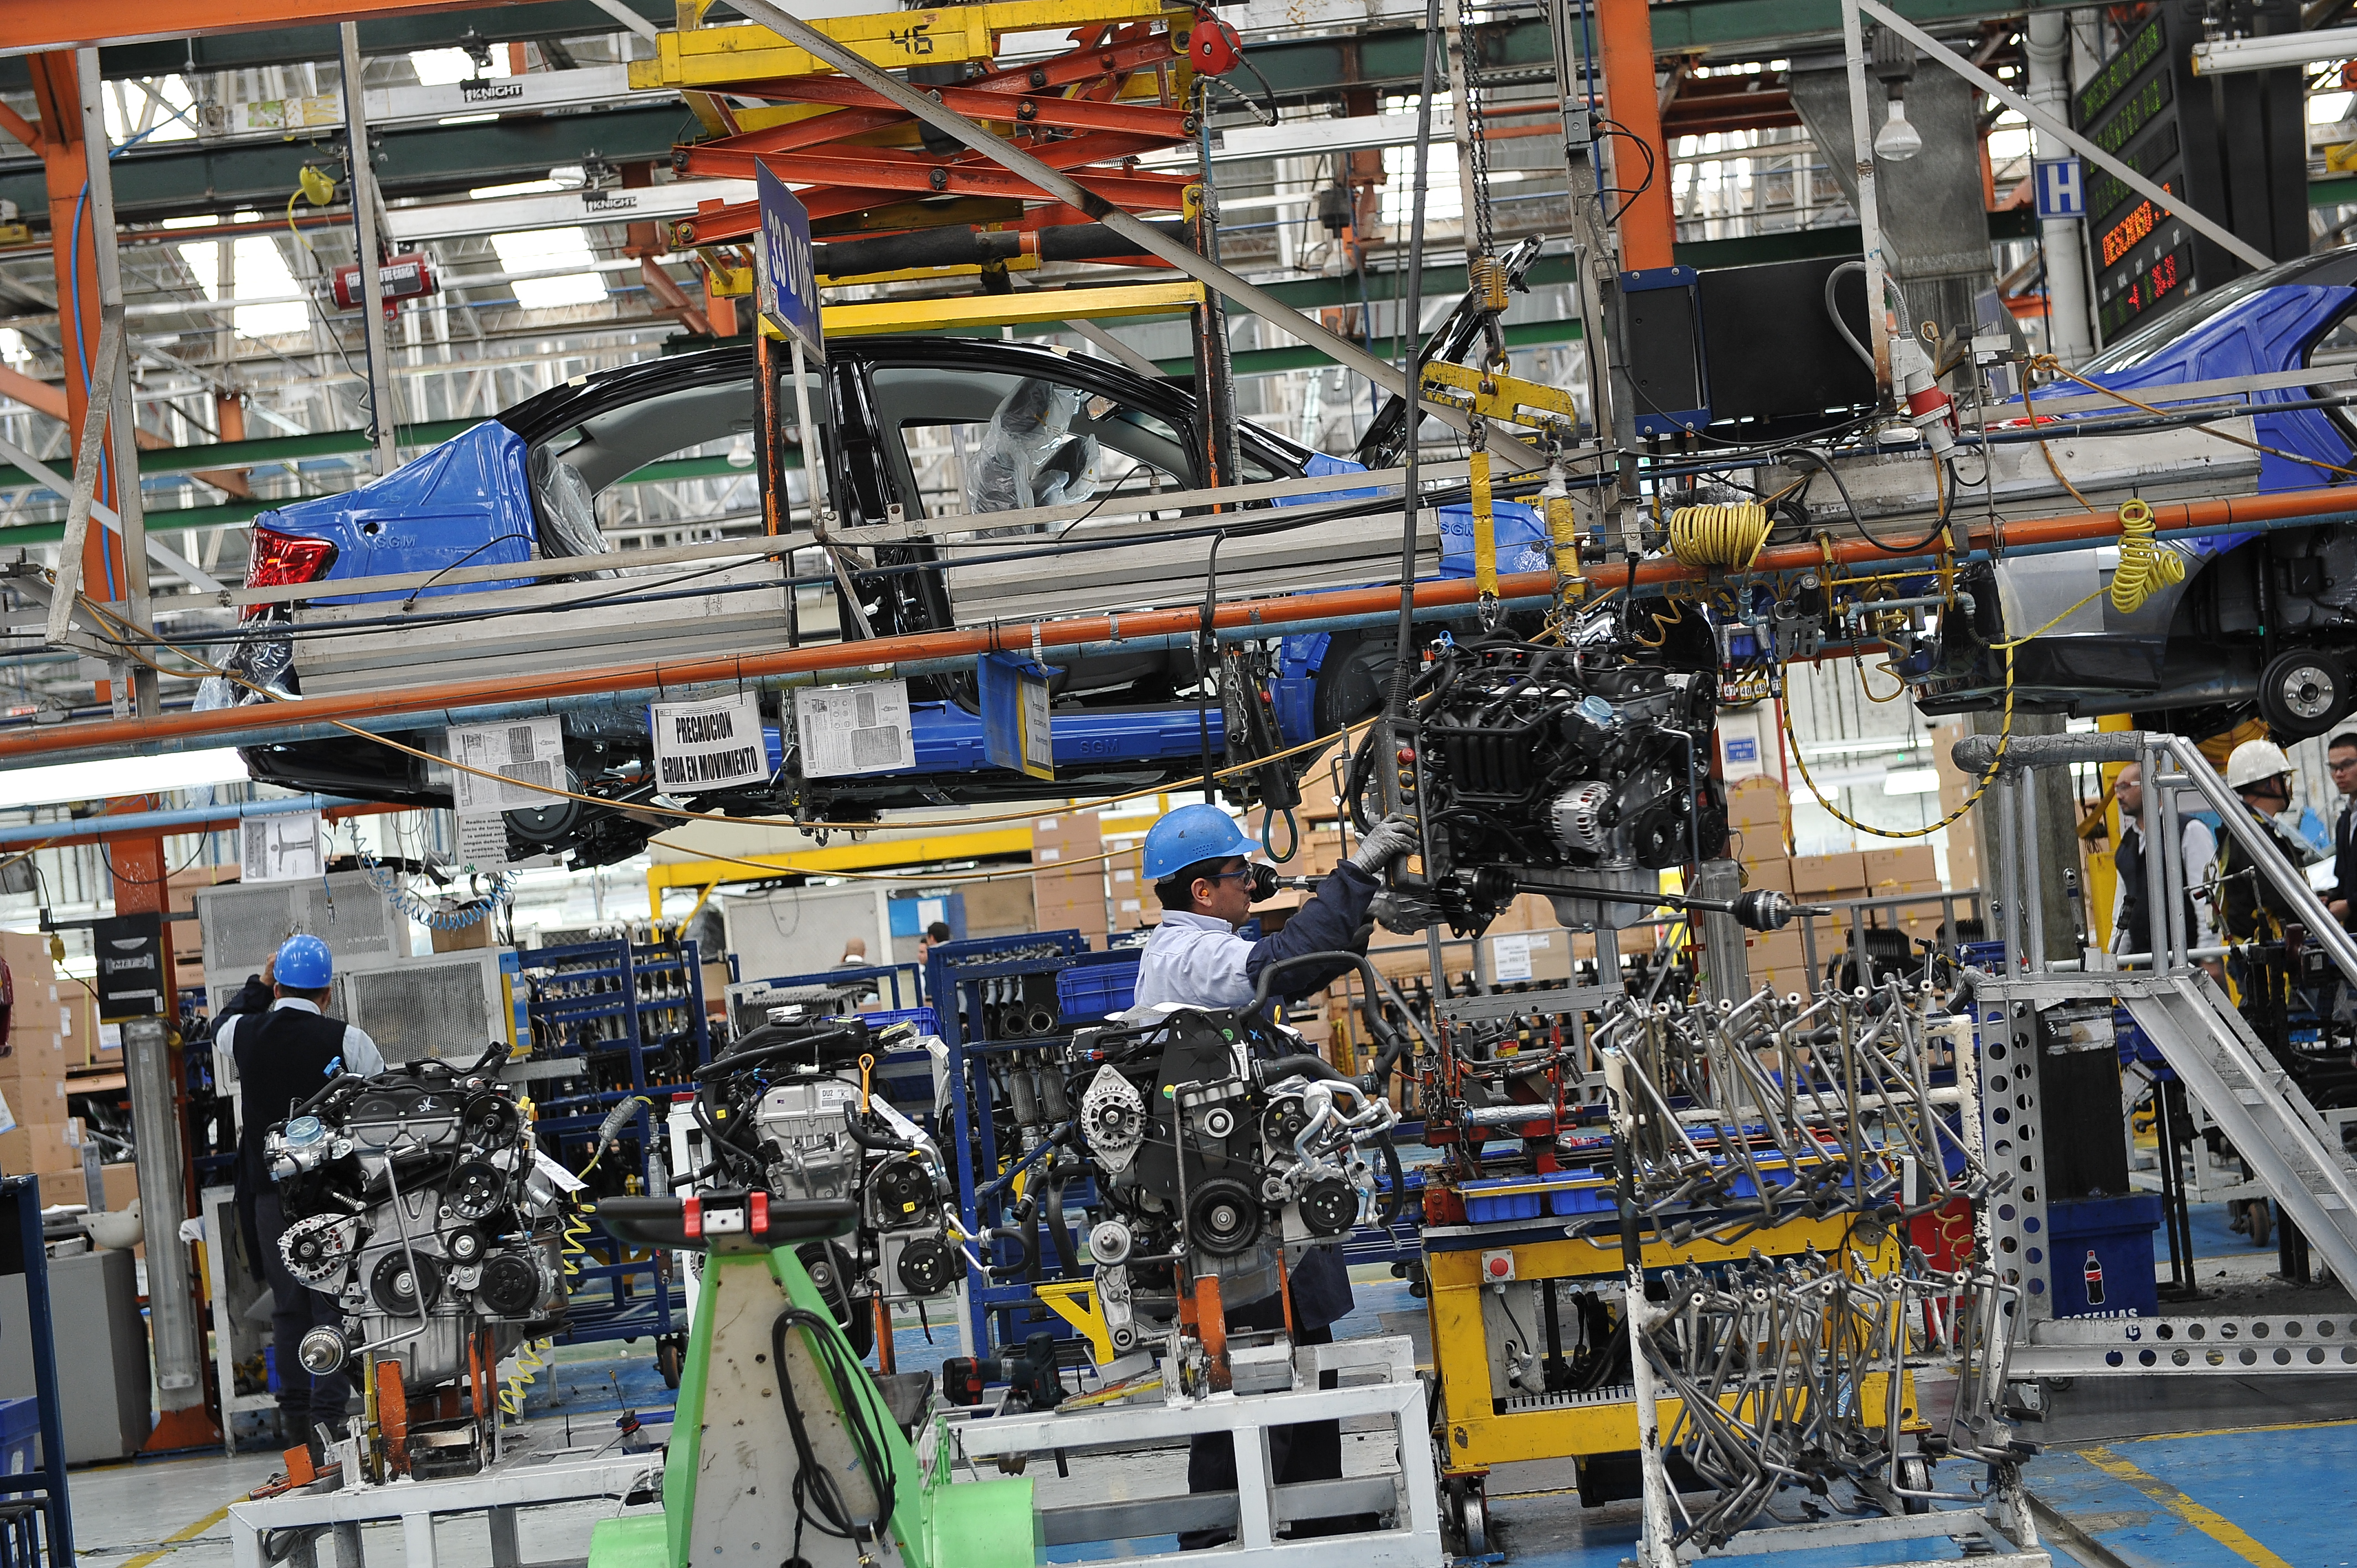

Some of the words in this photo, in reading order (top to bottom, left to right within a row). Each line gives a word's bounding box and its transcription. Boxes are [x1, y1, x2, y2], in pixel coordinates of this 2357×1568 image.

[889, 24, 933, 54] 46
[472, 85, 522, 100] KNIGHT
[2047, 164, 2081, 213] H
[593, 198, 637, 211] KNIGHT
[768, 209, 786, 287] 33
[796, 236, 814, 313] 06
[376, 535, 416, 548] SGM
[1726, 687, 1735, 695] 47
[1756, 684, 1766, 692] 48
[675, 711, 734, 744] PRECAUCION
[1080, 739, 1119, 754] SGM
[662, 756, 687, 783] GRUA
[686, 756, 699, 782] EN
[698, 746, 759, 781] MOVIMIENTO
